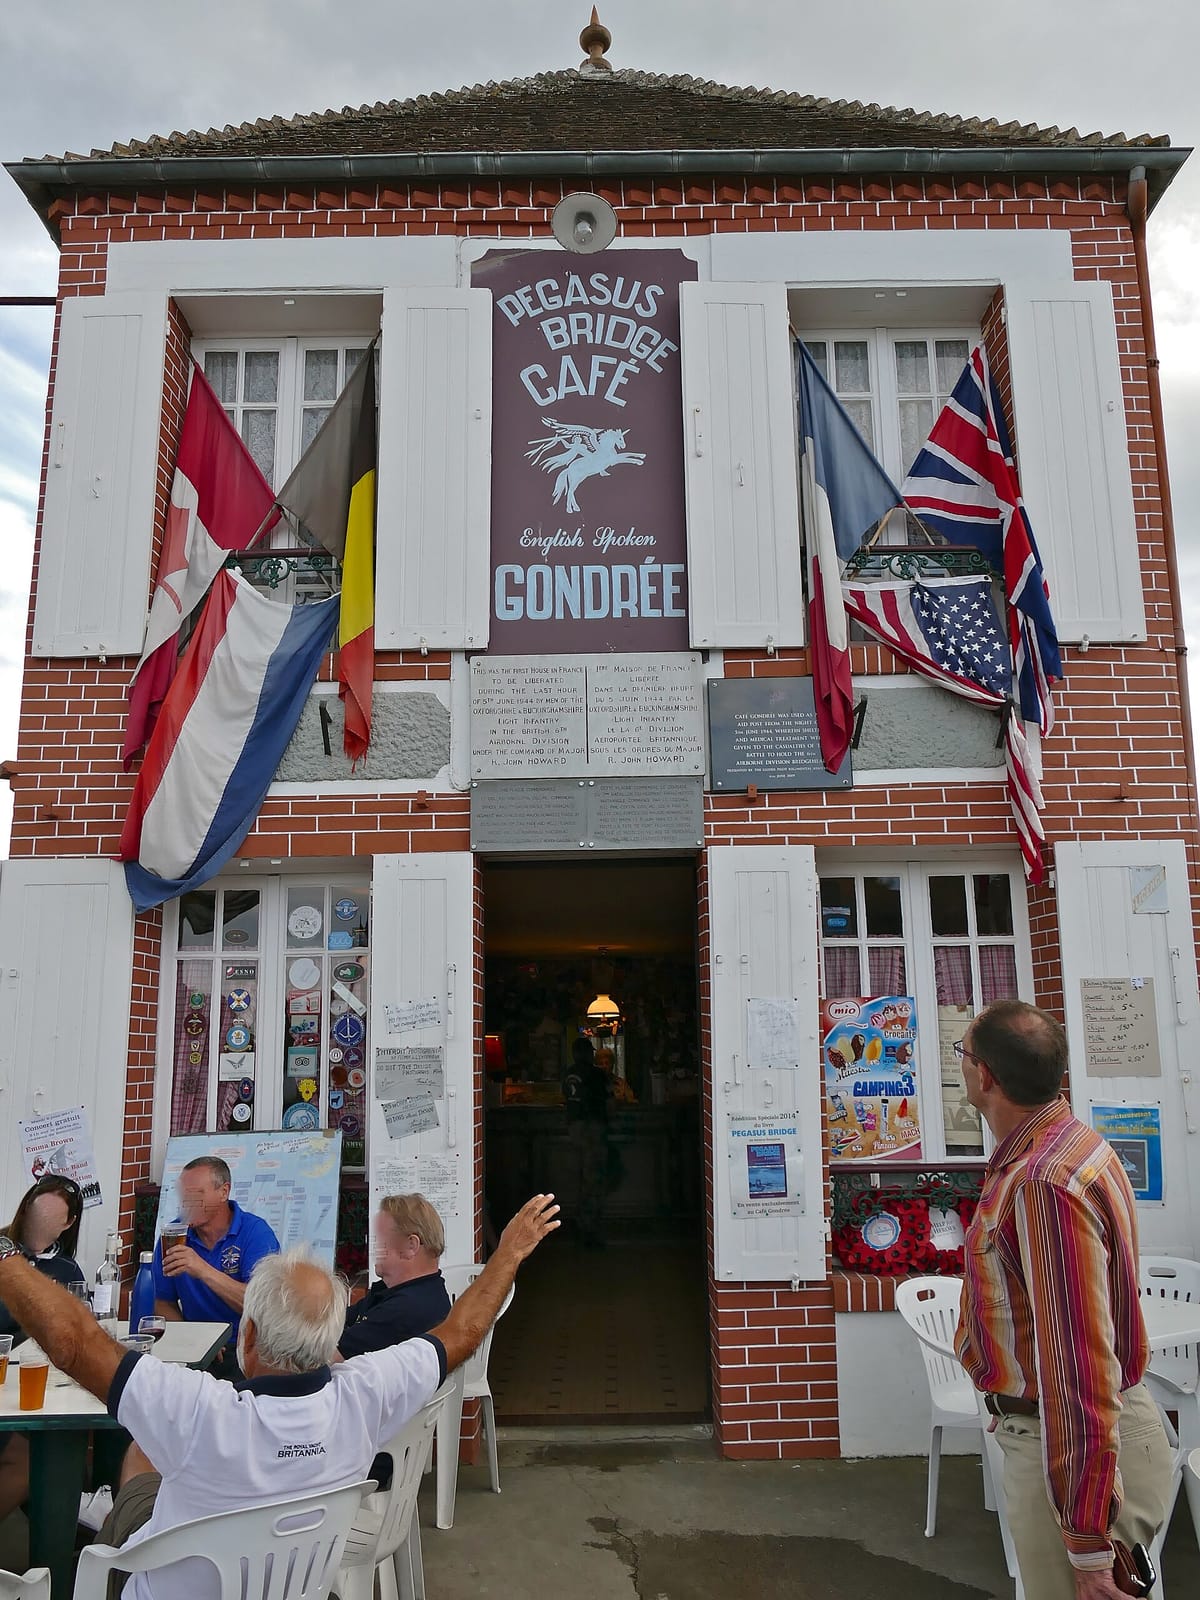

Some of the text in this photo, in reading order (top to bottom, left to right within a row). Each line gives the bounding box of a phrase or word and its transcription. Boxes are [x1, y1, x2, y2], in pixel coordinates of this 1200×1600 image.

[496, 273, 665, 327] PEGASUS
[540, 312, 679, 374] BRIDGE
[519, 355, 640, 407] CAFÉ
[519, 527, 657, 556] English Spoken
[495, 556, 686, 621] GONDRÉE
[558, 746, 586, 754] MAJOR
[528, 757, 567, 765] HOWARD
[834, 1005, 856, 1014] mio
[24, 1114, 81, 1133] Concert gratuit
[768, 1128, 798, 1136] BRIDGE
[25, 1136, 74, 1153] Emma Brown
[278, 1446, 327, 1458] BRITANNIA
